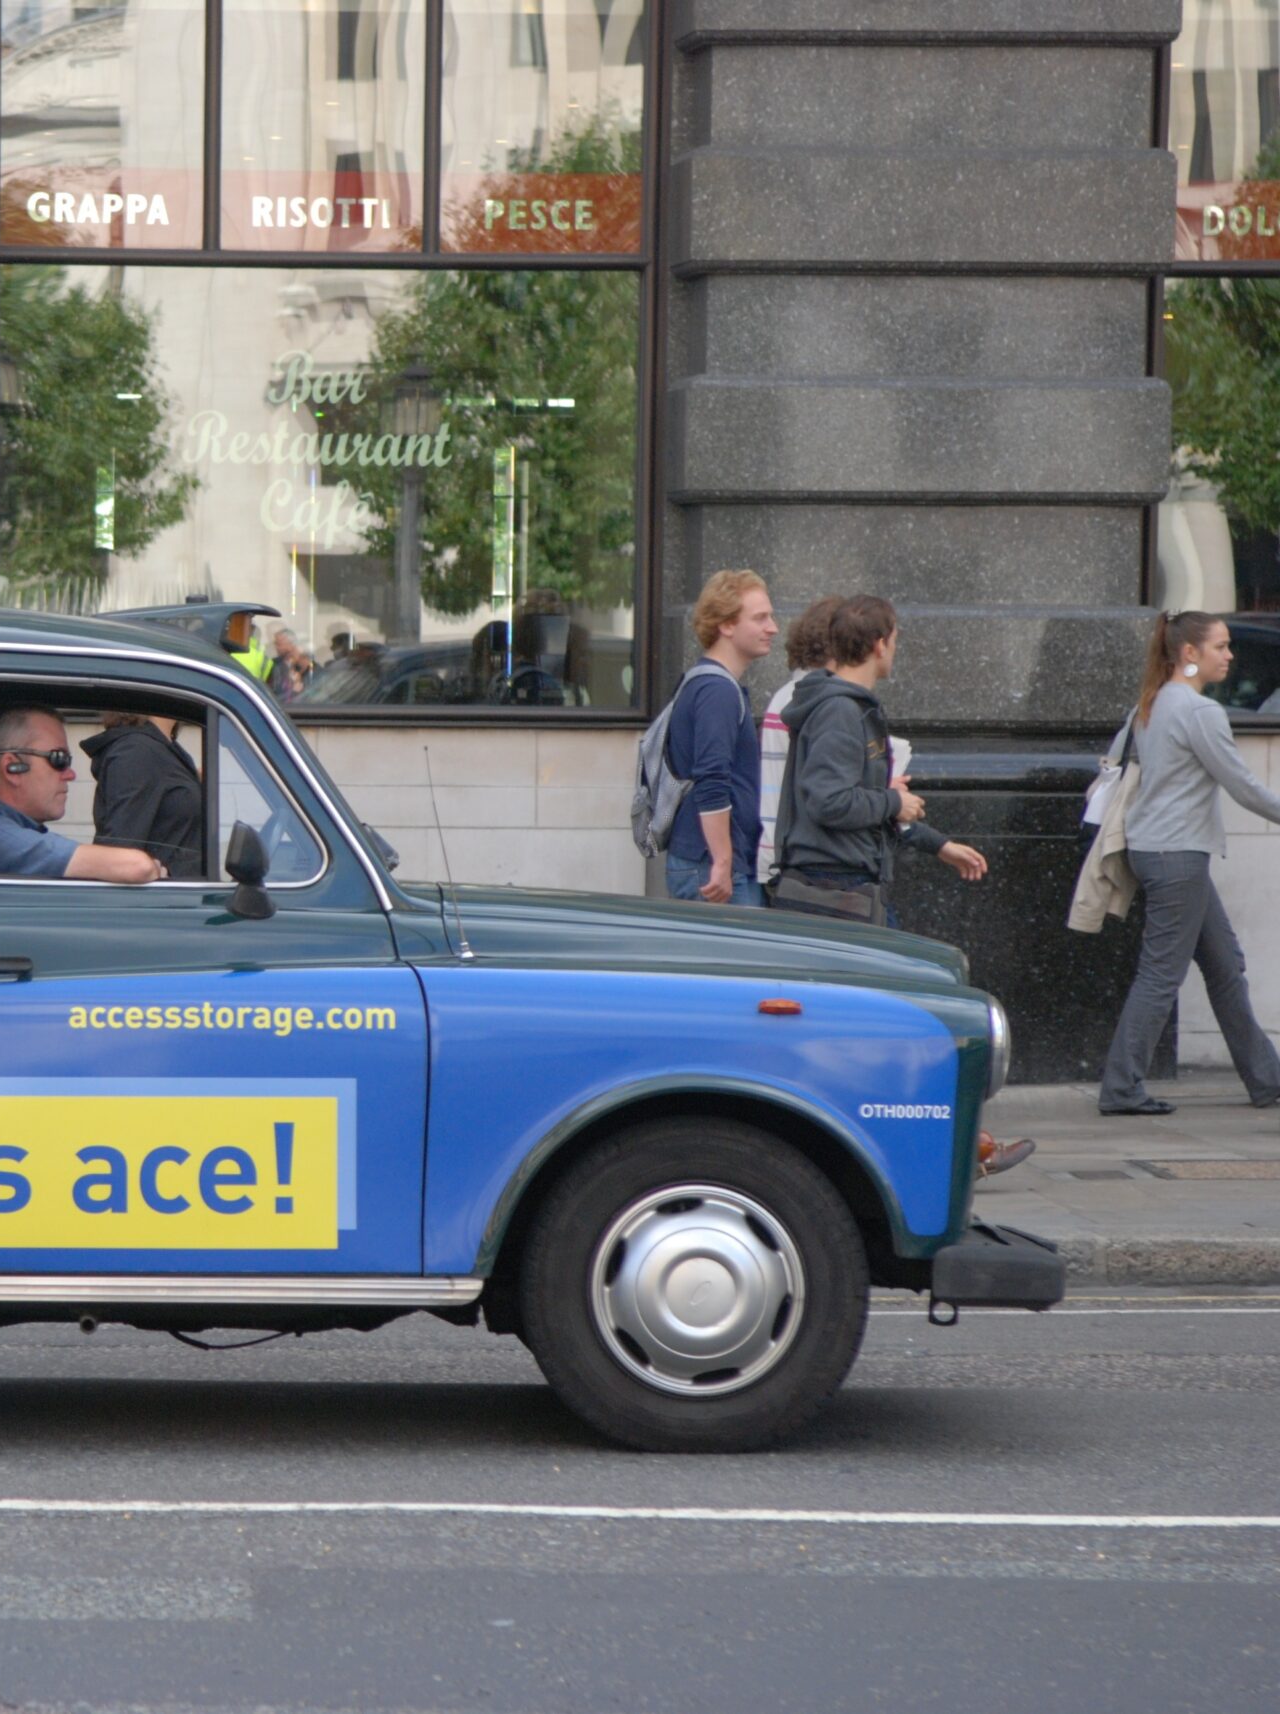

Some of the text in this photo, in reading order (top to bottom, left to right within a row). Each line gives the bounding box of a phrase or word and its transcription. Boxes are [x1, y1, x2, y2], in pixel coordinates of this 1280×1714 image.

[26, 191, 170, 226] GRAPPA
[250, 195, 391, 230] RISOTTI
[483, 198, 595, 231] PESCE
[1202, 204, 1280, 237] DOL
[270, 350, 368, 405] Bar
[181, 409, 453, 468] Restaurant
[260, 478, 375, 551] Café
[68, 1001, 397, 1036] accessstorage.com
[859, 1103, 952, 1120] OTH000702
[71, 1121, 296, 1214] ace!
